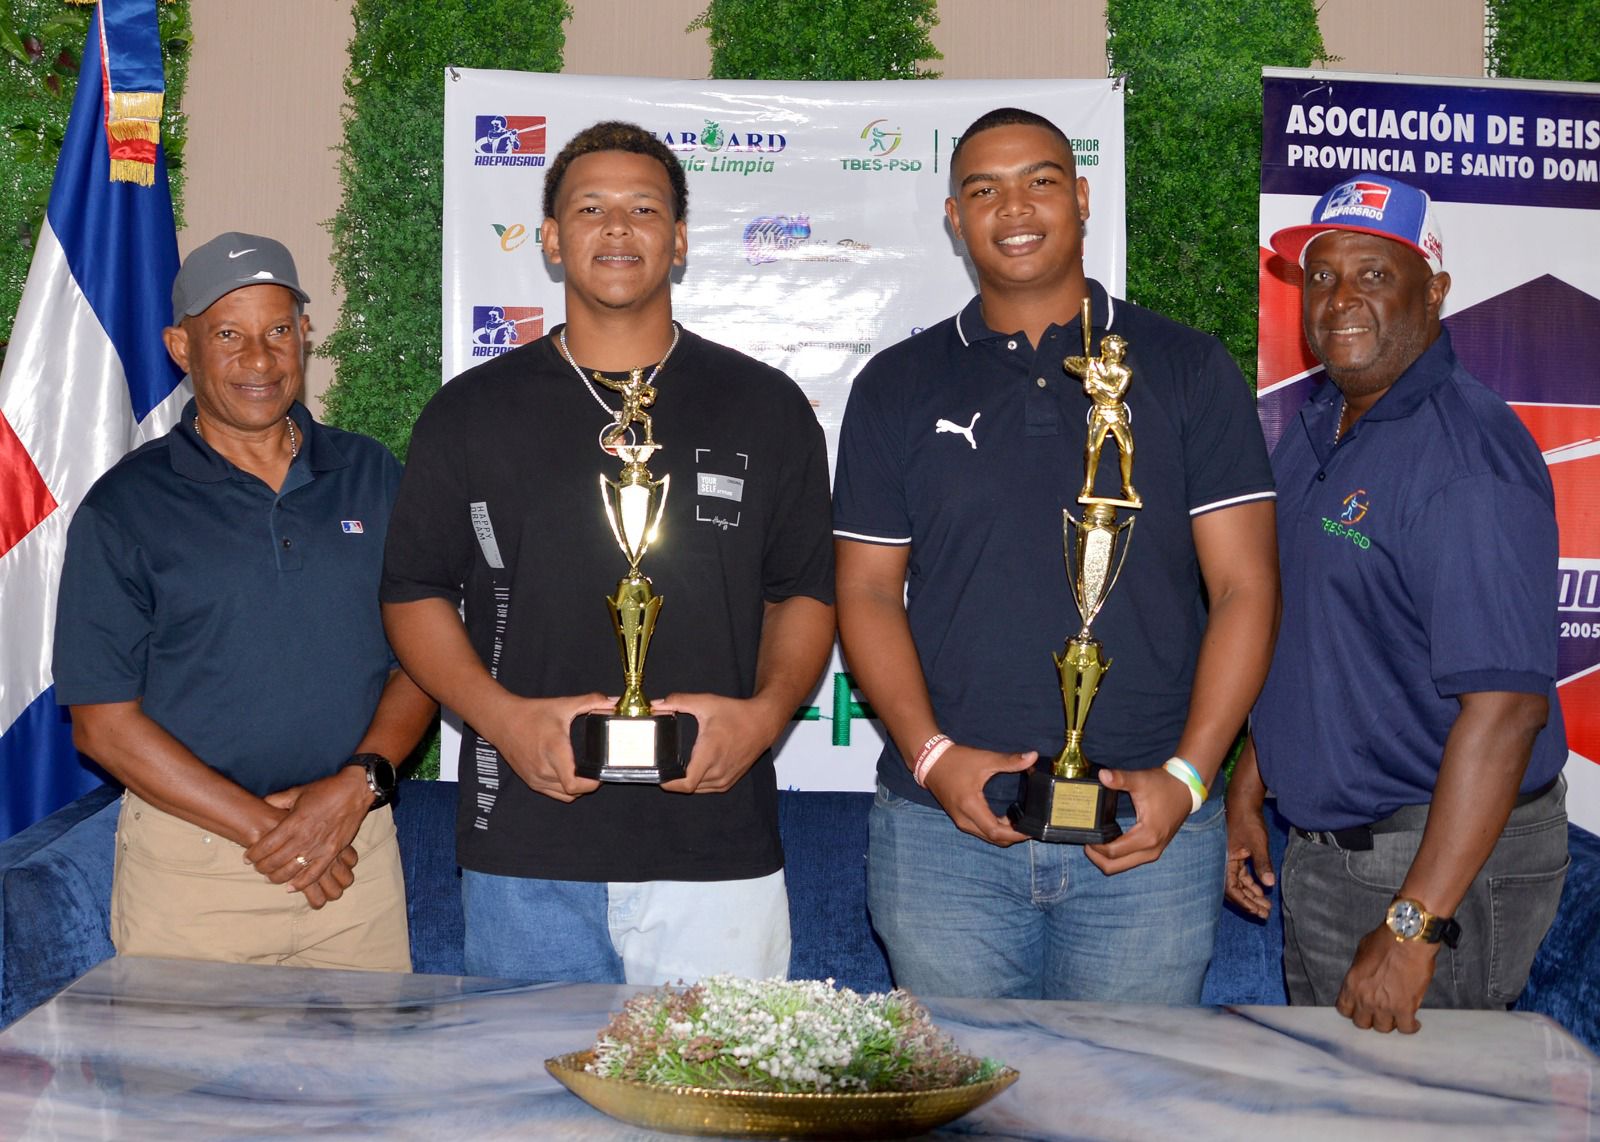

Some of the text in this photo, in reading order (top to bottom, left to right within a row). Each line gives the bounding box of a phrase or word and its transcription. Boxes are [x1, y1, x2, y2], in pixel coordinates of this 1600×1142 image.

[1286, 103, 1475, 143] ASOCIACIÓN
[1487, 115, 1525, 146] DE
[1068, 138, 1099, 152] ERIOR
[474, 155, 546, 167] ABEPROSADO
[710, 156, 775, 176] Limpia
[840, 158, 922, 172] TBES-PSD
[1074, 154, 1099, 166] INGO
[1287, 144, 1600, 183] PROVINCIA DE SANTO DOM
[472, 345, 516, 357] ABEPR
[1560, 622, 1600, 638] 2005
